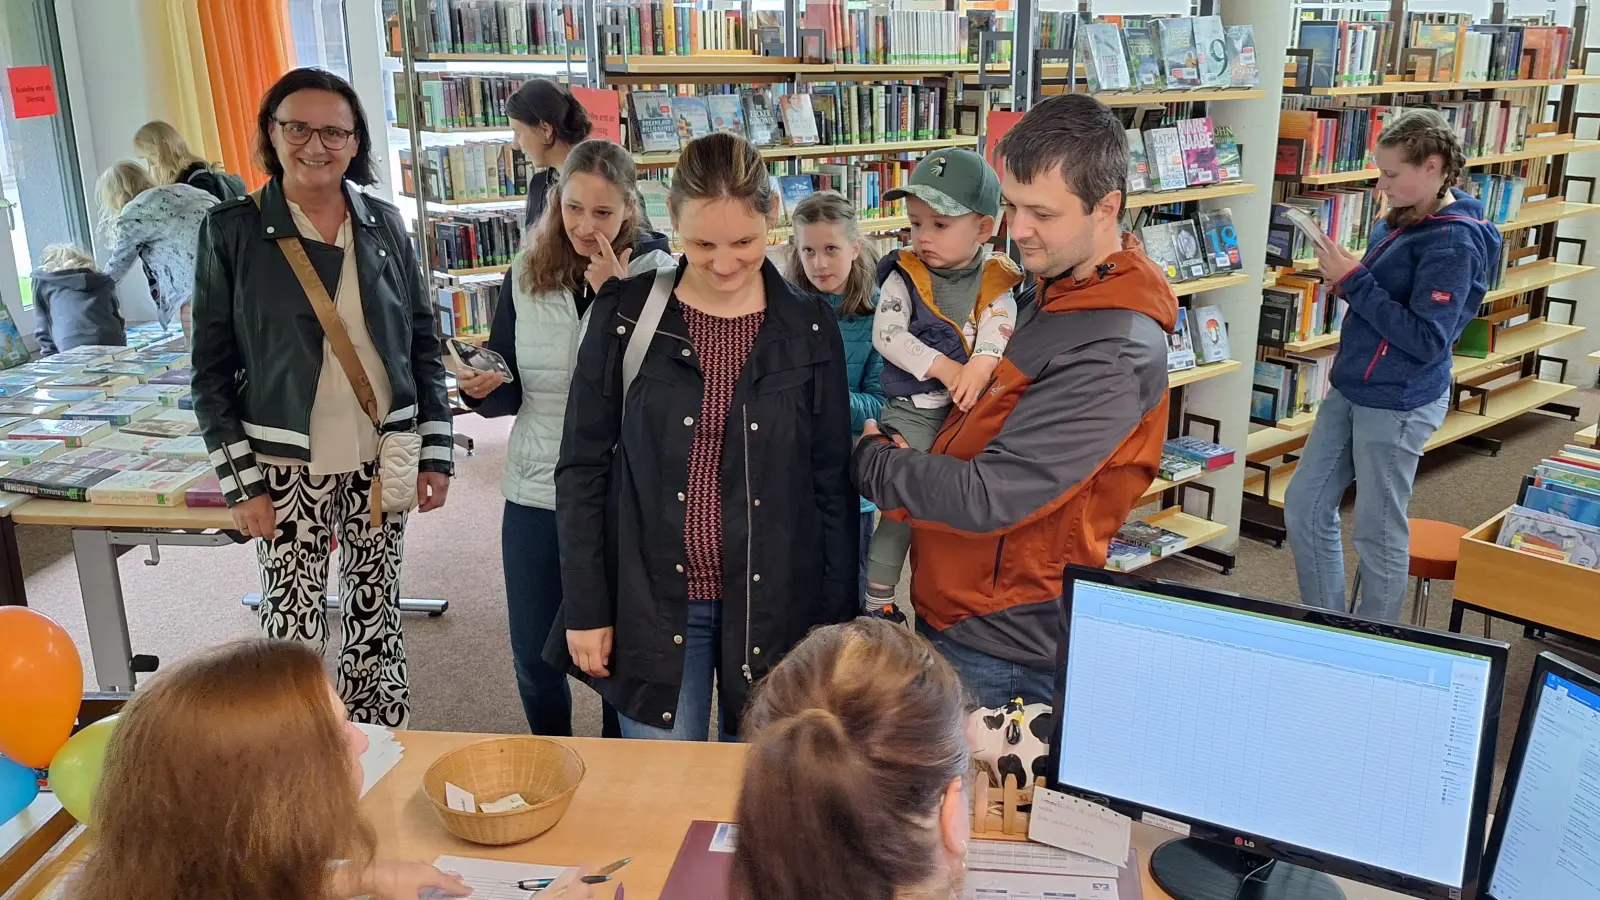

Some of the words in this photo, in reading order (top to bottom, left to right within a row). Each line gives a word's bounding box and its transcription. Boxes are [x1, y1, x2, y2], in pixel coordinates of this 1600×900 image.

[1213, 126, 1234, 136] OHN
[1180, 132, 1215, 150] RAABE
[1244, 840, 1255, 848] LG
